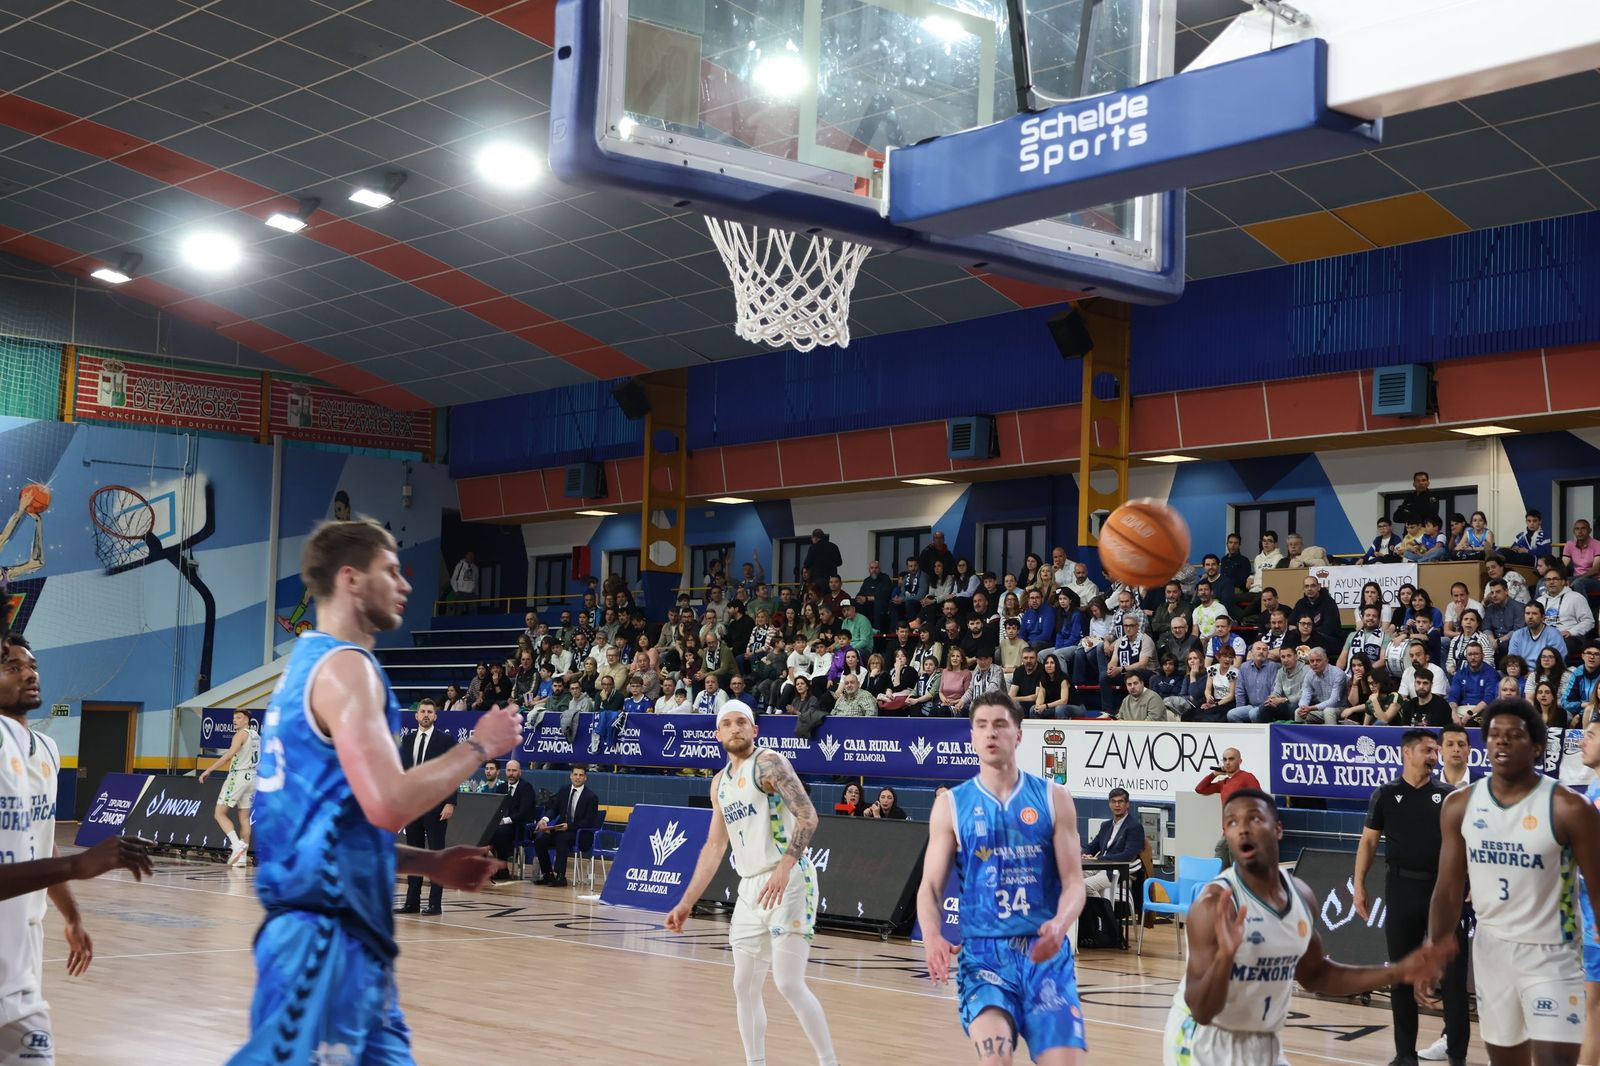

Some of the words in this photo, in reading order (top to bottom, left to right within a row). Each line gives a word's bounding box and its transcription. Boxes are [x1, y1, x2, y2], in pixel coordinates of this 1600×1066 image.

[1020, 95, 1148, 146] Schelde
[1019, 122, 1148, 174] Sports
[134, 377, 241, 401] AYUNTAMIENTO
[133, 391, 157, 411] DE
[160, 394, 241, 421] ZAMORA
[1334, 591, 1349, 605] DE
[537, 740, 574, 754] ZAMORA
[679, 744, 721, 759] ZAMORA
[757, 737, 779, 749] CAJA
[781, 738, 810, 750] RURAL
[844, 739, 867, 751] CAJA
[869, 740, 902, 753] RURAL
[937, 741, 961, 754] CAJA
[844, 752, 853, 761] DE
[856, 753, 886, 763] ZAMORA
[937, 756, 948, 764] DE
[1085, 731, 1220, 773] ZAMORA
[1281, 763, 1329, 786] CAJA
[1333, 765, 1398, 787] RURAL
[1084, 776, 1169, 792] AYUNTAMIENTO
[160, 798, 201, 817] INNOVA
[1481, 840, 1525, 853] HESTIA
[1469, 847, 1545, 870] MENORCA
[626, 868, 649, 882] CAJA
[649, 870, 682, 885] RURAL
[626, 882, 638, 891] DE
[638, 884, 668, 895] ZAMORA
[1498, 877, 1510, 901] 3
[995, 887, 1031, 919] 34
[945, 914, 959, 925] DE
[1262, 996, 1272, 1022] 1
